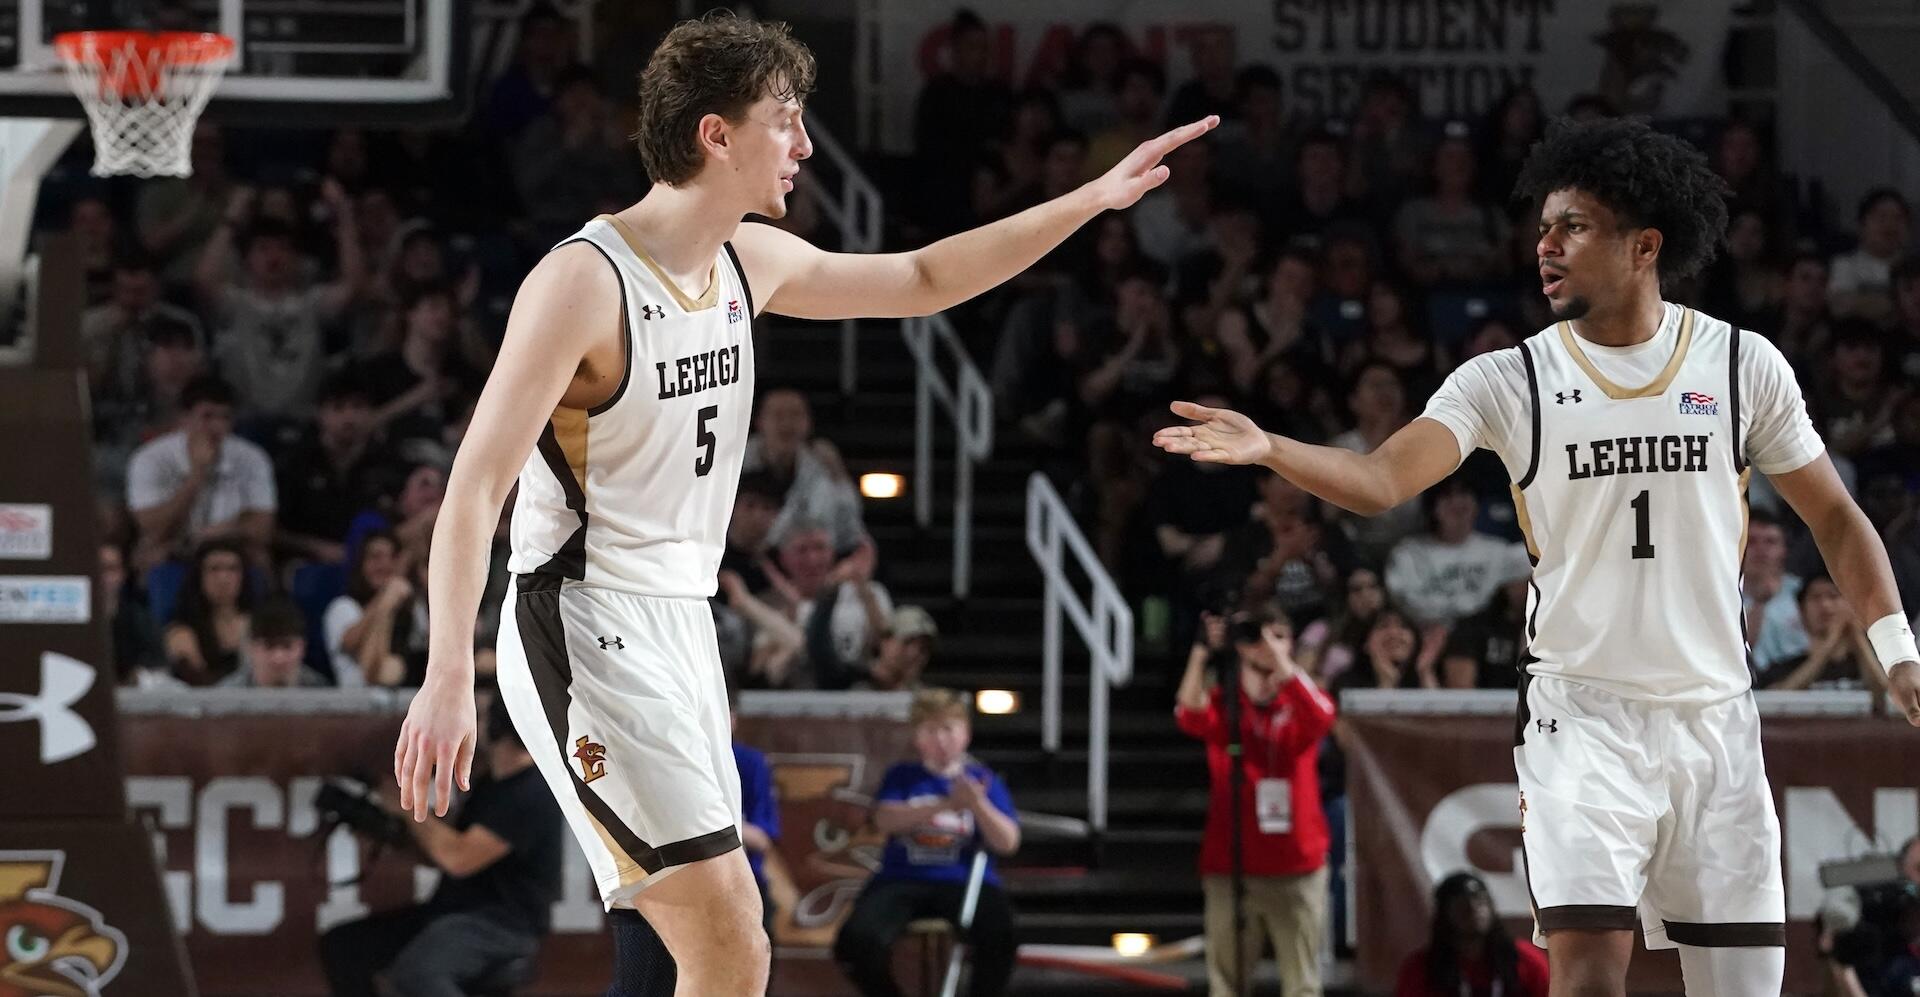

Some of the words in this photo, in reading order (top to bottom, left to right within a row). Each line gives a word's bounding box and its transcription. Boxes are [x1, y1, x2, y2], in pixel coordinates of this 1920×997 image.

[1273, 0, 1554, 50] STUDENT
[1290, 64, 1538, 117] SETION
[1679, 403, 1719, 411] PATRIOT
[694, 404, 718, 478] 5
[1565, 435, 1709, 481] LEHIGH
[1630, 489, 1655, 559] 1
